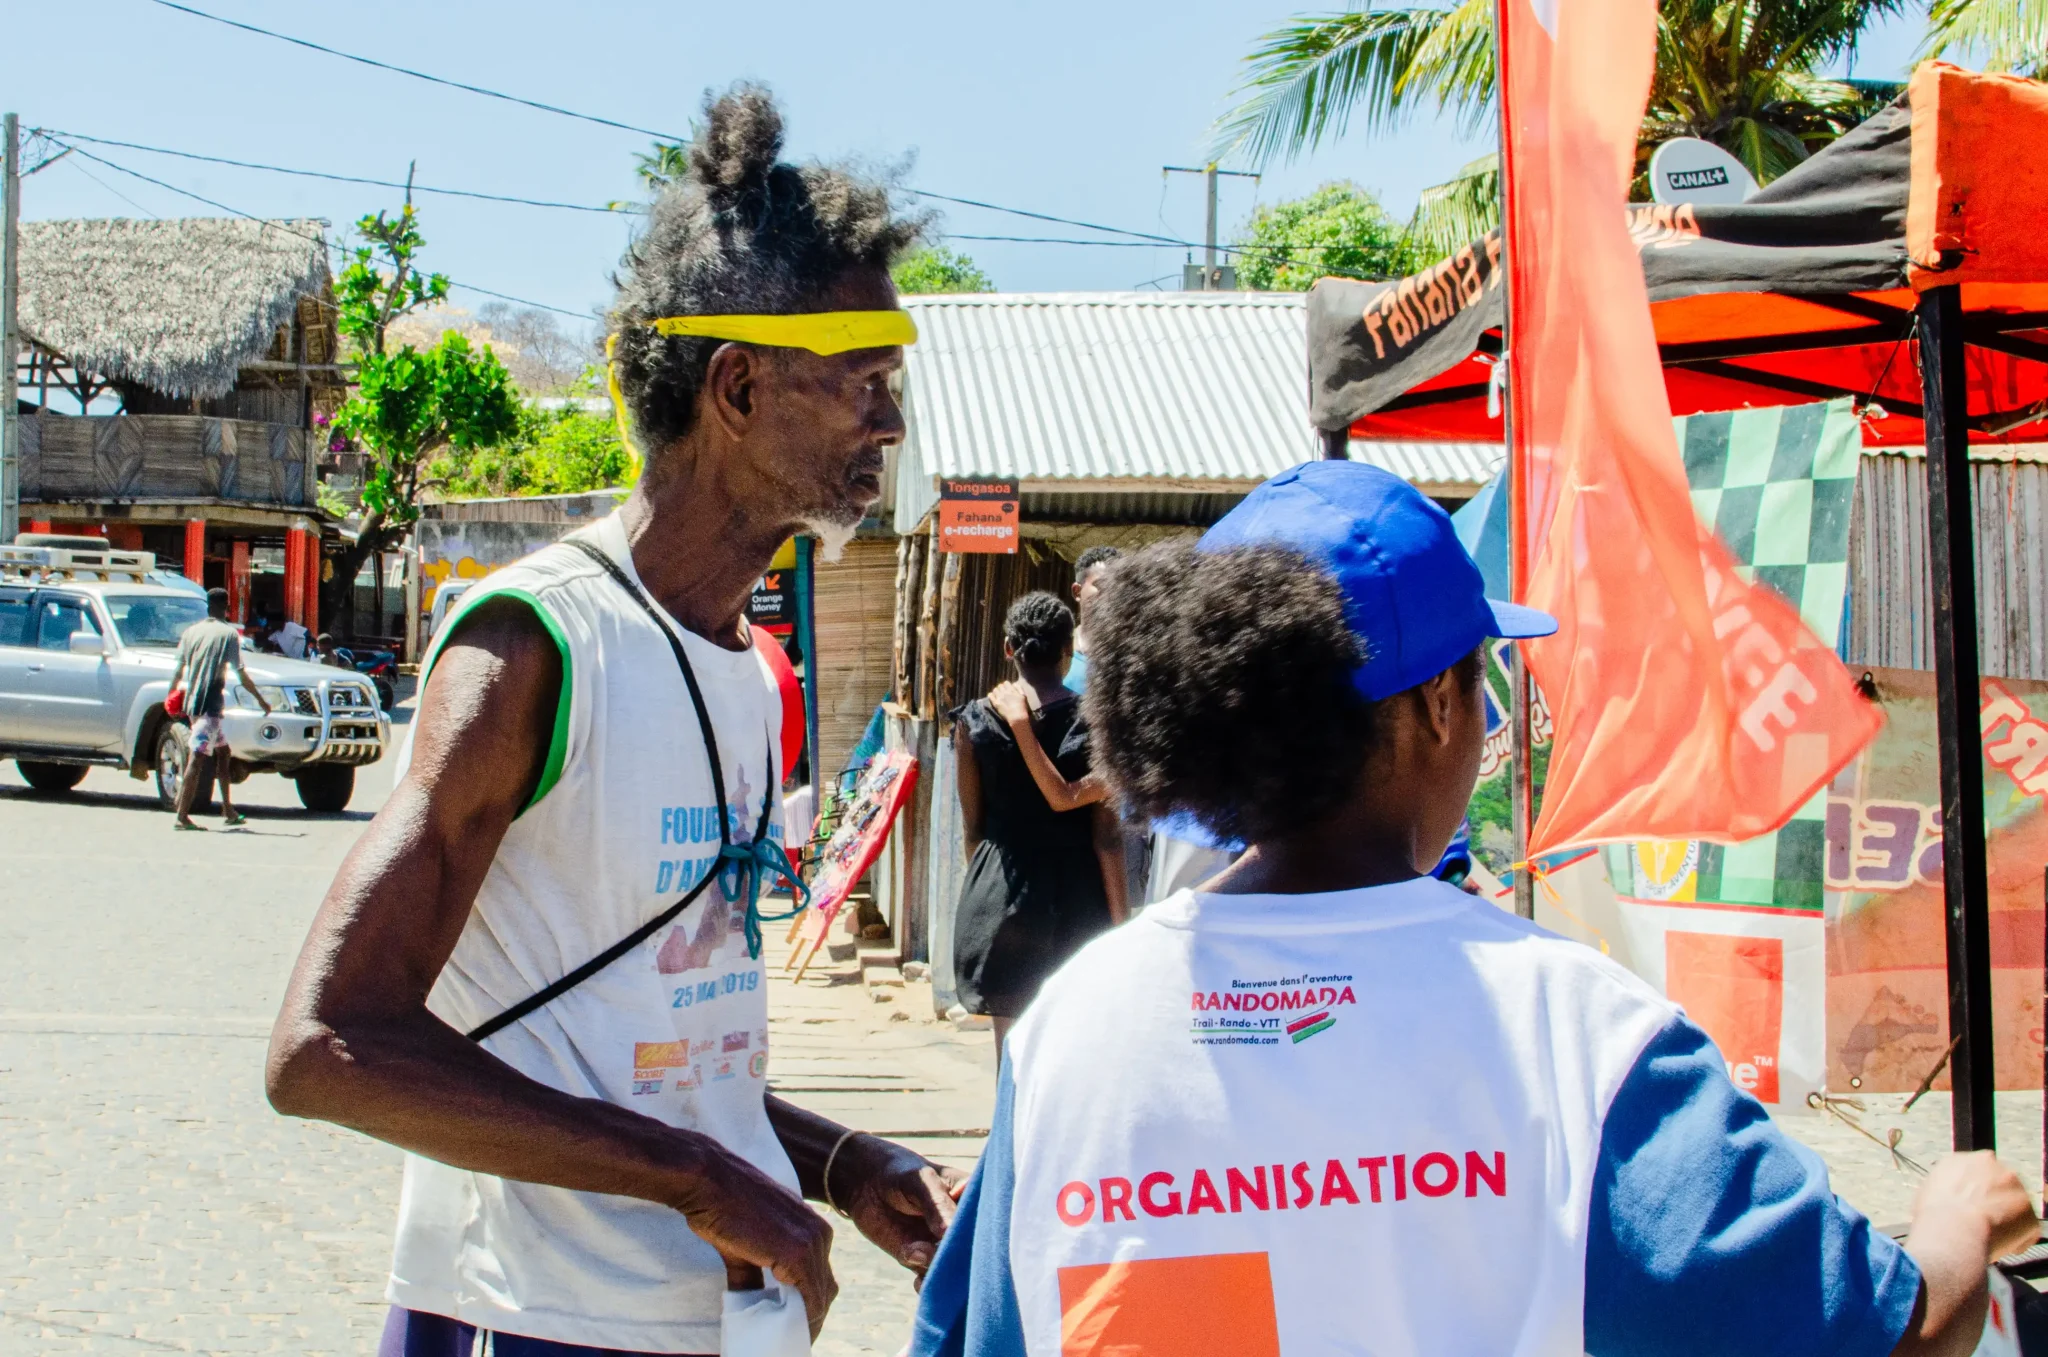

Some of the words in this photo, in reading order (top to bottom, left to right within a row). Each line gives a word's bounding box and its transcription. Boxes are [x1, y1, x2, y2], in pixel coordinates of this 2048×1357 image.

[1669, 170, 1725, 189] CANAL+
[947, 481, 1012, 497] Tongasoa
[957, 511, 1003, 523] Fahana
[944, 524, 1014, 539] e-recharge
[751, 594, 783, 604] Orange
[752, 603, 782, 612] Money
[1232, 979, 1278, 989] Bienvenue
[1280, 975, 1301, 986] dans
[1302, 974, 1353, 985] l'aventure
[672, 985, 694, 1009] 25
[1191, 986, 1357, 1012] RANDOMADA
[1192, 1034, 1279, 1045] www.randomada.com
[1056, 1150, 1507, 1228] ORGANISATION
